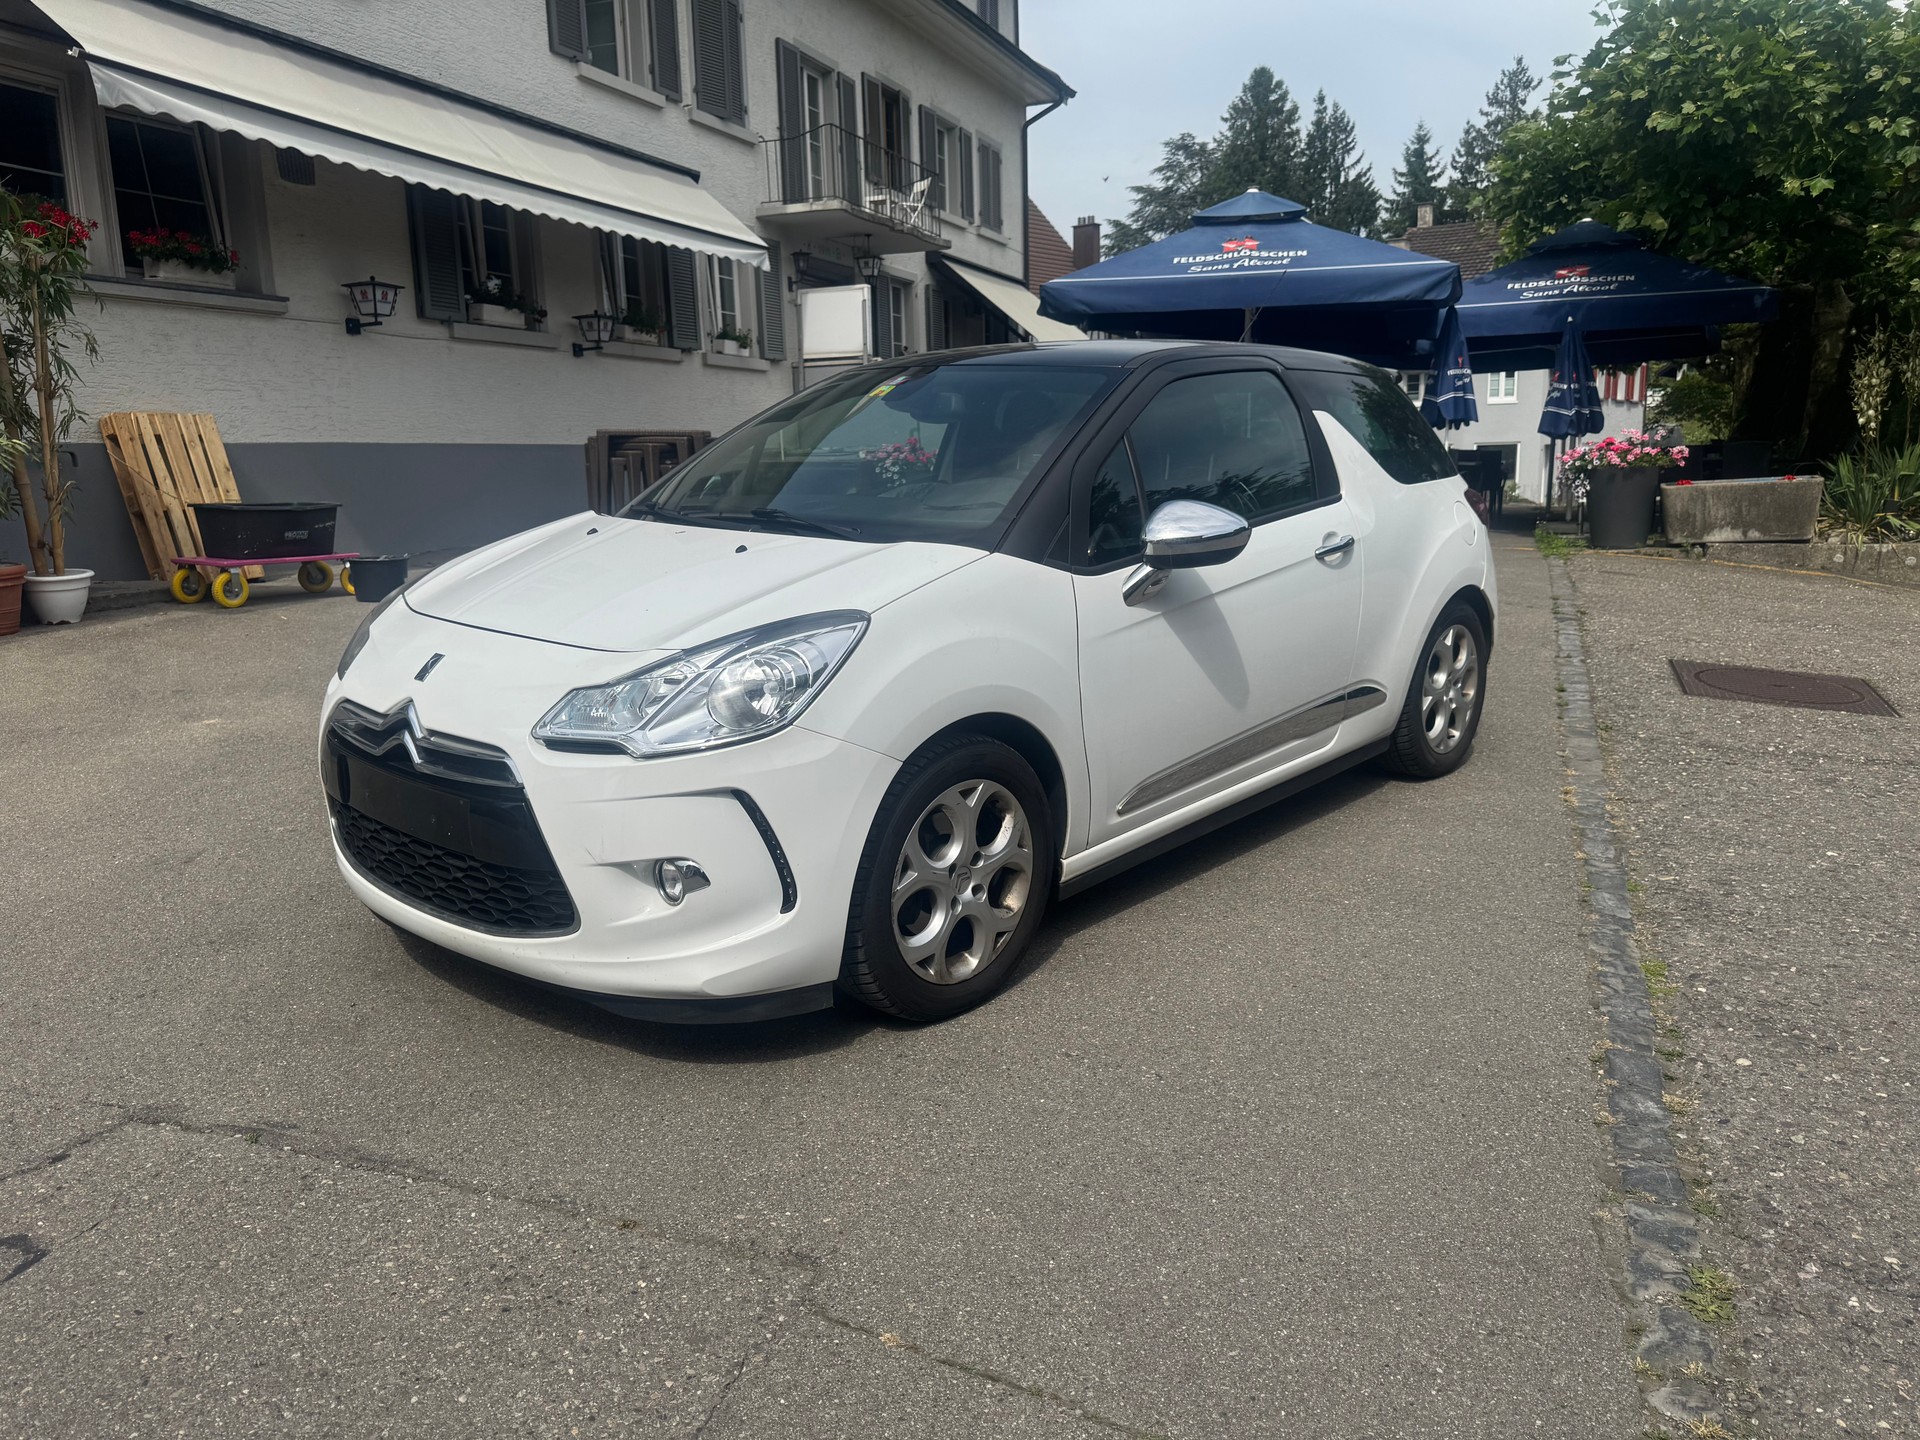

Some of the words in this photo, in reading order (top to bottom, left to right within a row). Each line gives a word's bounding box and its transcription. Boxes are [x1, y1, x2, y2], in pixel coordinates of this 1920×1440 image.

[1173, 248, 1308, 264] FELDSCHLÖSSCHEN
[1187, 263, 1230, 273] Sans
[1232, 257, 1291, 269] Alcool
[1507, 275, 1635, 290] FELDSCHLÖSSCHEN
[1520, 289, 1560, 299] Sans
[1562, 283, 1618, 295] Alcool
